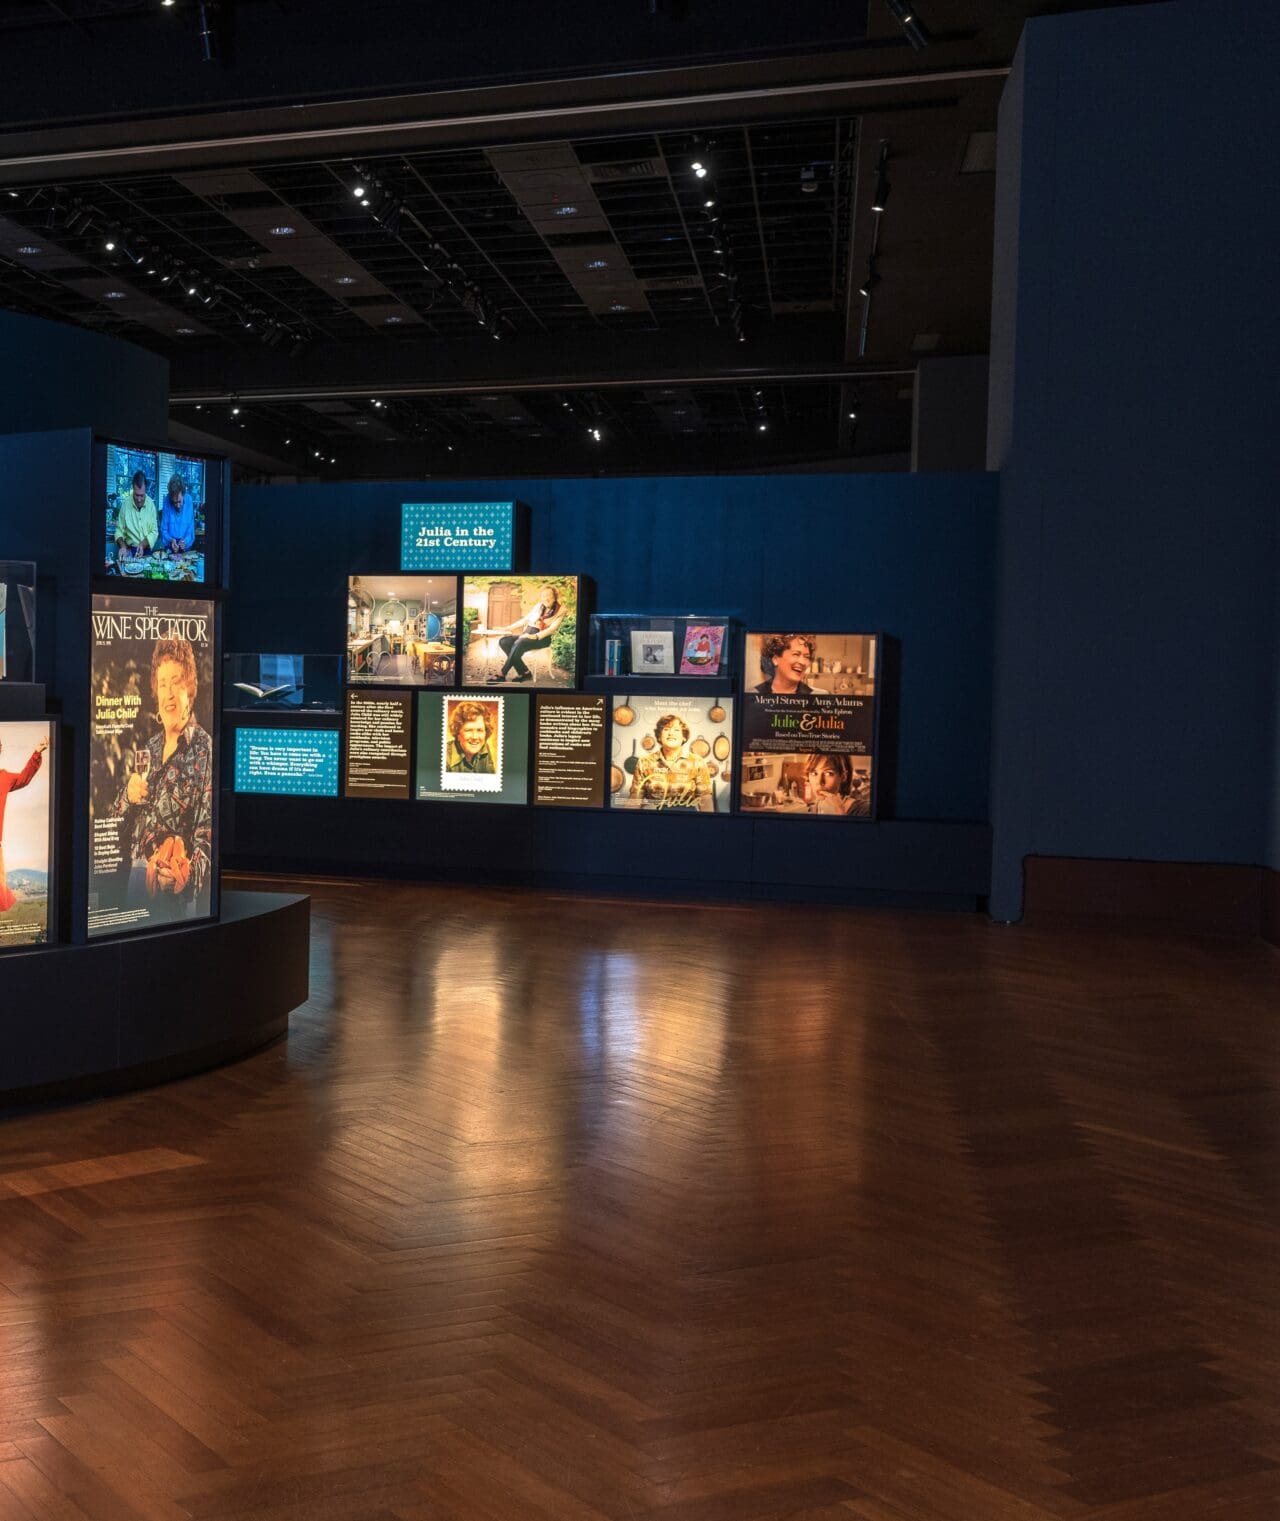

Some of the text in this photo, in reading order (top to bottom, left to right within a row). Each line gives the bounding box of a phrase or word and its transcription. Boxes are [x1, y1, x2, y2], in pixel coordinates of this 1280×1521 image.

[419, 526, 494, 536] Julia in the
[416, 537, 496, 548] 21st Century
[144, 606, 158, 616] THE
[92, 616, 207, 641] WINE SPECTATOR
[96, 695, 141, 706] Dinner With
[755, 696, 863, 708] Meryl Streep Amy Adams
[96, 709, 115, 719] Julia
[771, 714, 844, 731] Julie & Julia
